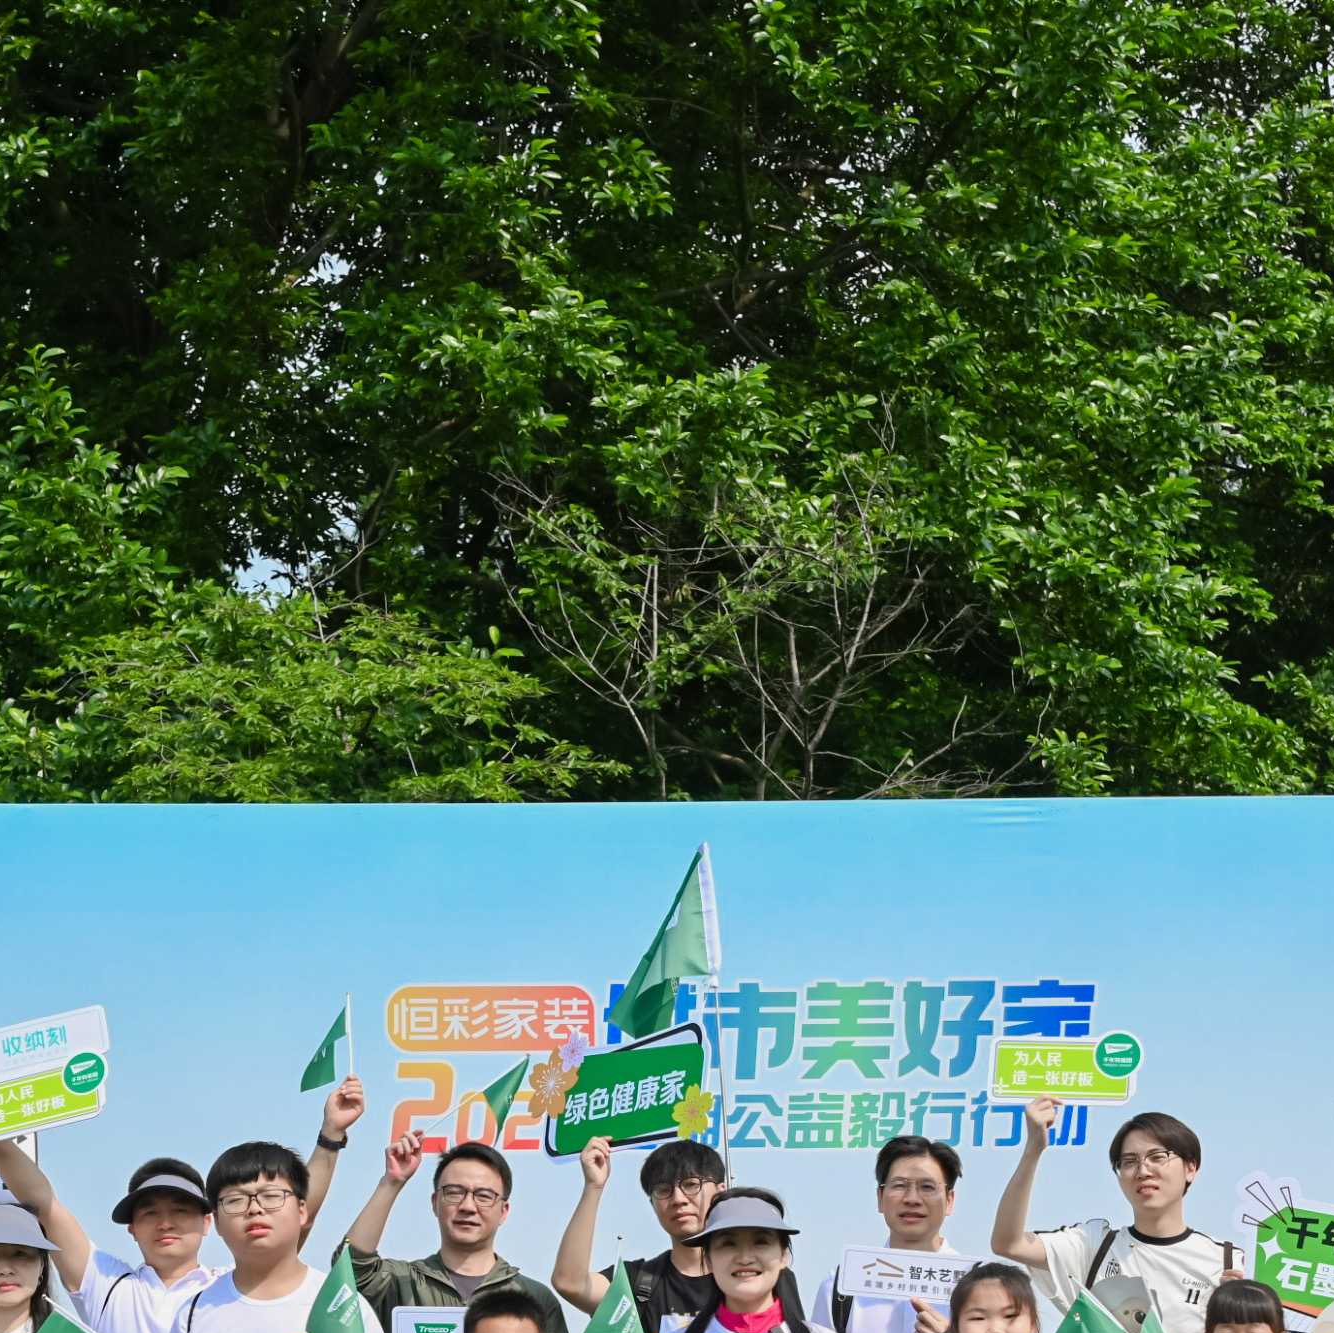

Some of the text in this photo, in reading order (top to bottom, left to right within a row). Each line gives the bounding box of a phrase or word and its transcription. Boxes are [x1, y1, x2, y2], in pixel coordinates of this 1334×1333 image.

[393, 997, 590, 1041] 恒彩家装
[1, 1025, 68, 1057] 收纳刻
[1012, 1050, 1063, 1068] 为人民
[1011, 1069, 1094, 1087] 造一张好板
[391, 1061, 543, 1154] 202
[563, 1070, 687, 1126] 绿色健康家
[908, 1265, 968, 1284] 智木艺墅
[864, 1280, 952, 1296] 高端乡村别墅引领
